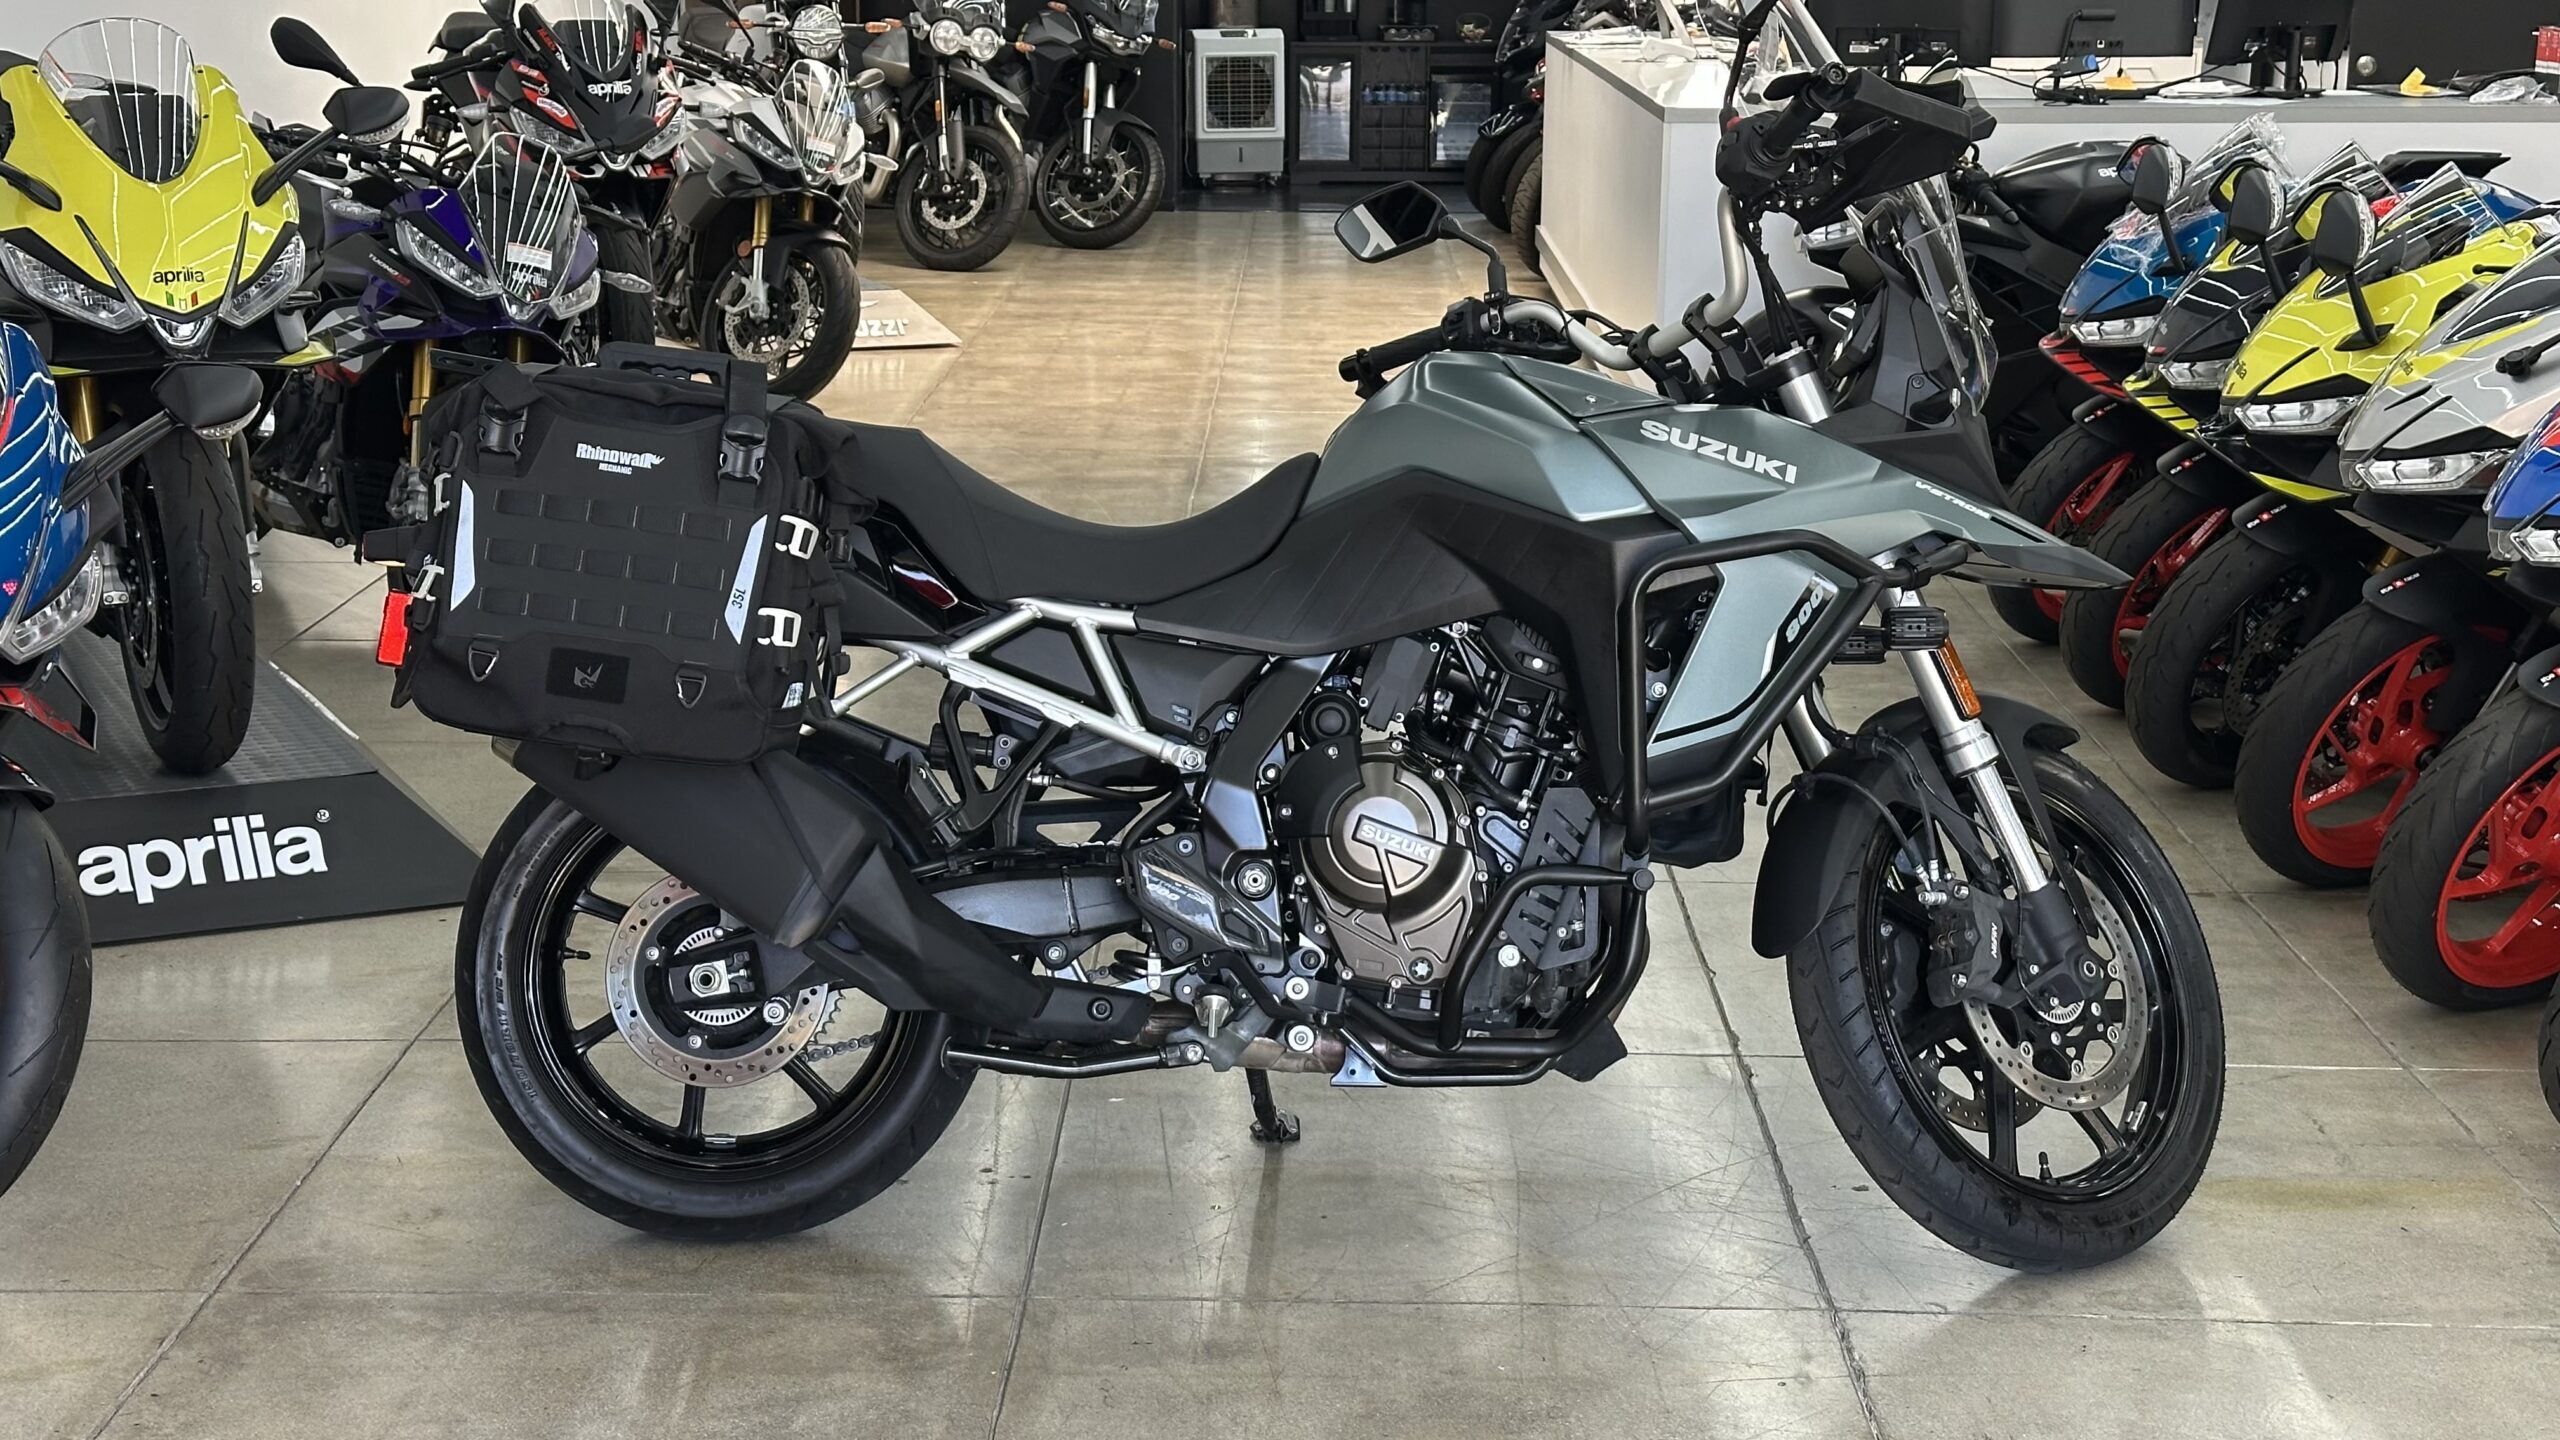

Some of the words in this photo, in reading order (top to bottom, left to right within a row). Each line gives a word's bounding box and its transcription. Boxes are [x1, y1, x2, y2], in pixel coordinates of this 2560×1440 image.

[587, 79, 633, 97] aprilia
[152, 266, 205, 286] aprilia
[511, 267, 548, 289] aprilia
[575, 442, 666, 469] Rhinowalk
[1639, 418, 1798, 485] SUZUKI
[598, 462, 633, 475] MECHANIC
[731, 588, 747, 609] 35L
[1785, 584, 1824, 643] 800
[1360, 823, 1437, 861] SUZUKI
[77, 813, 329, 905] aprilia
